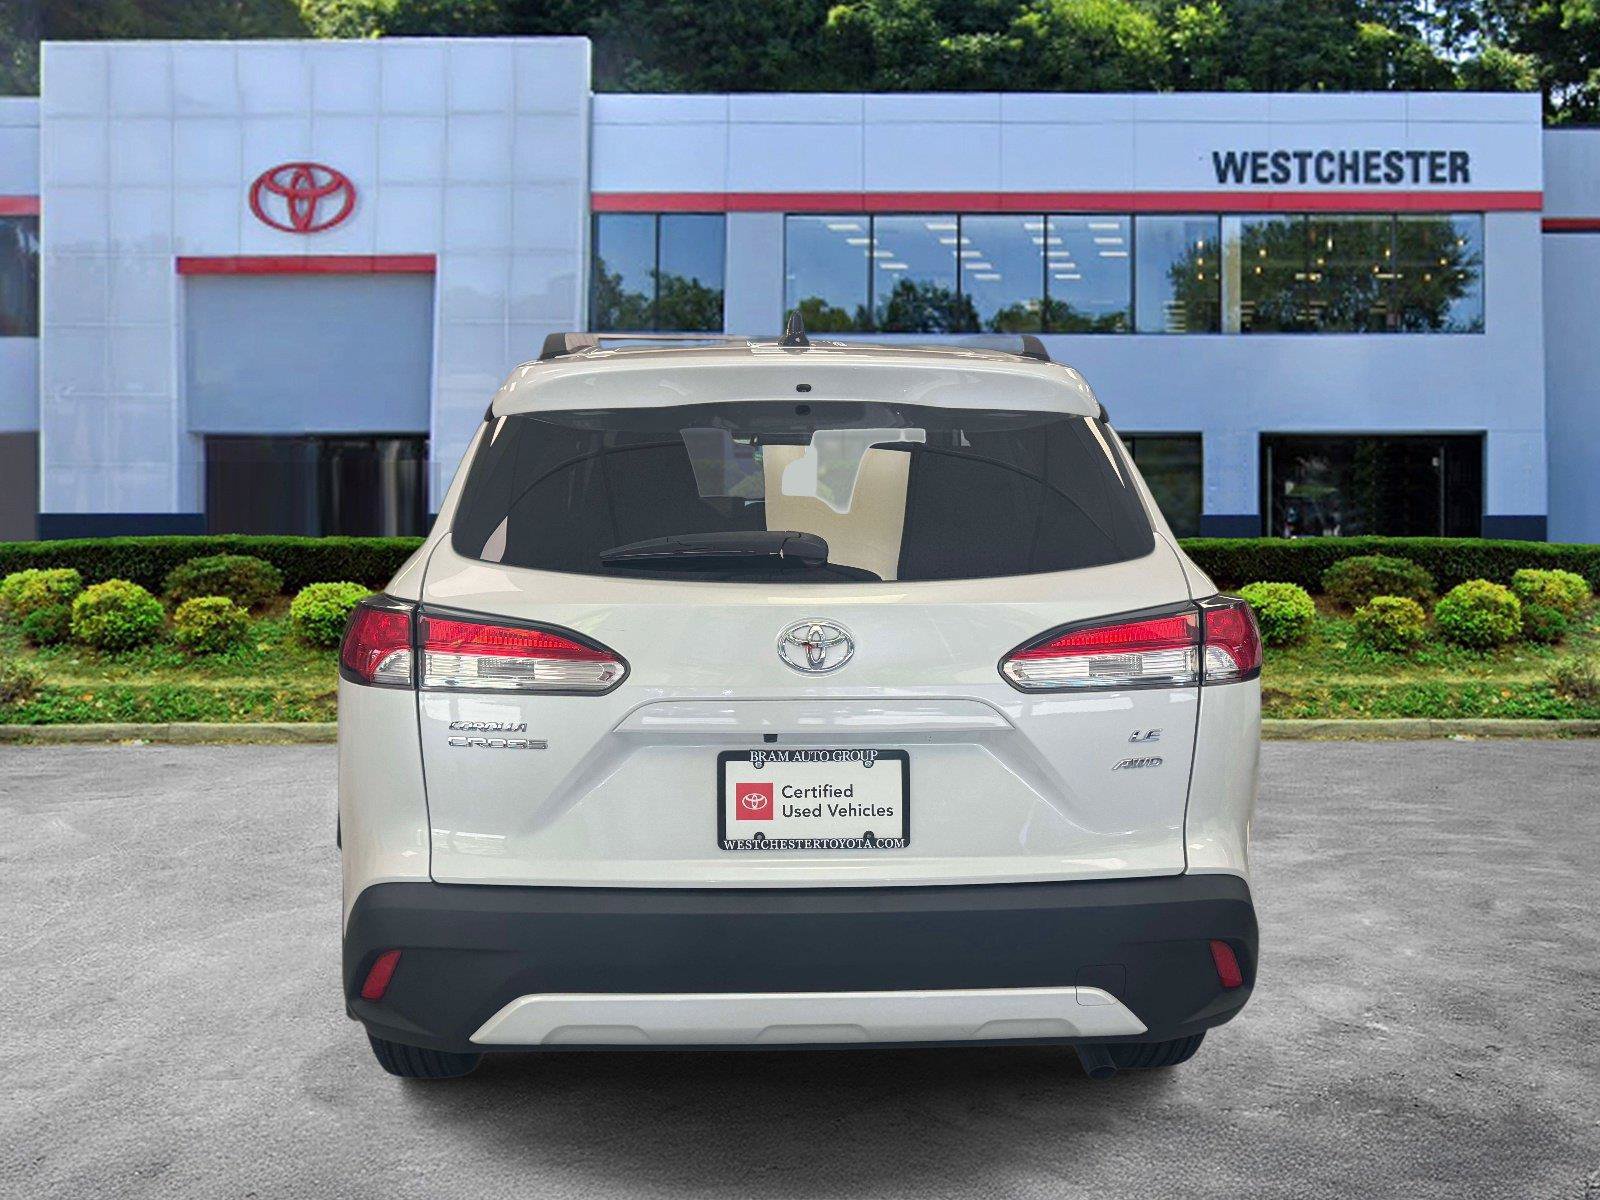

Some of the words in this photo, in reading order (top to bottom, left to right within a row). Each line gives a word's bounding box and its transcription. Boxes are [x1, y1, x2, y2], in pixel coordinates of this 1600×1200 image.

[1212, 150, 1471, 185] WESTCHESTER
[448, 721, 528, 733] COROLLA
[1128, 728, 1163, 742] LE
[447, 736, 548, 749] CROSS
[750, 750, 789, 762] BRAM
[794, 750, 829, 762] AUTO
[832, 750, 878, 762] GROUP
[1111, 757, 1163, 770] AWD
[781, 784, 854, 799] Certified
[782, 804, 822, 818] Used
[827, 803, 894, 817] Vehicles
[723, 838, 906, 850] WESTCHESTERTOYOTA.COM
